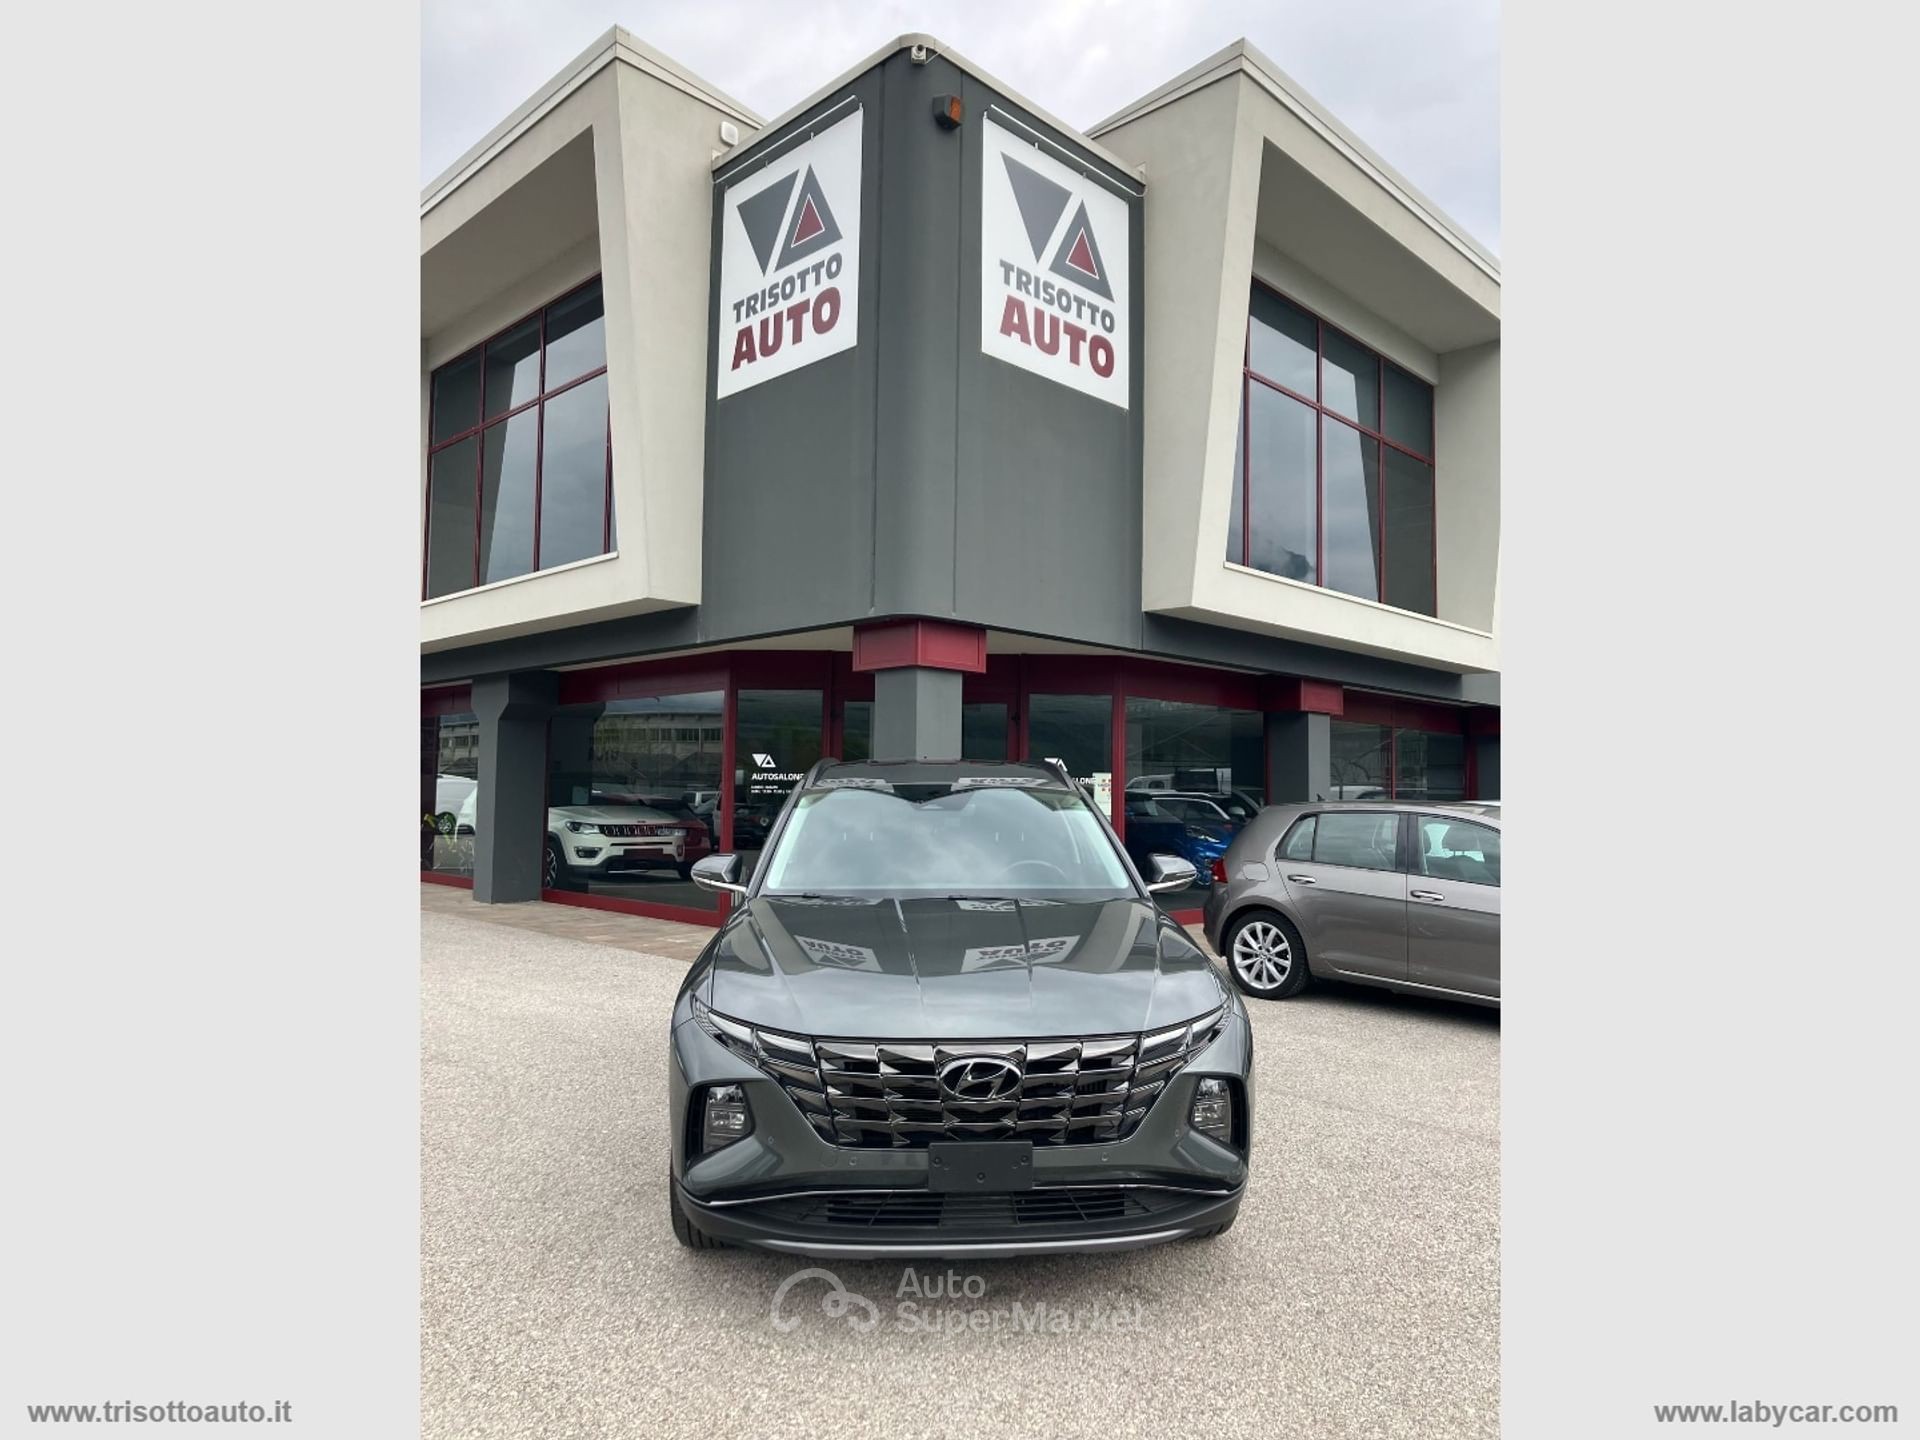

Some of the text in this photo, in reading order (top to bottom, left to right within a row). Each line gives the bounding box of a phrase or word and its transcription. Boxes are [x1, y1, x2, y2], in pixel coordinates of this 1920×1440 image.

[732, 252, 843, 324] TRISOTTO
[999, 258, 1116, 334] TRISOTTO
[731, 286, 842, 371] AUTO
[999, 294, 1115, 379] AUTO
